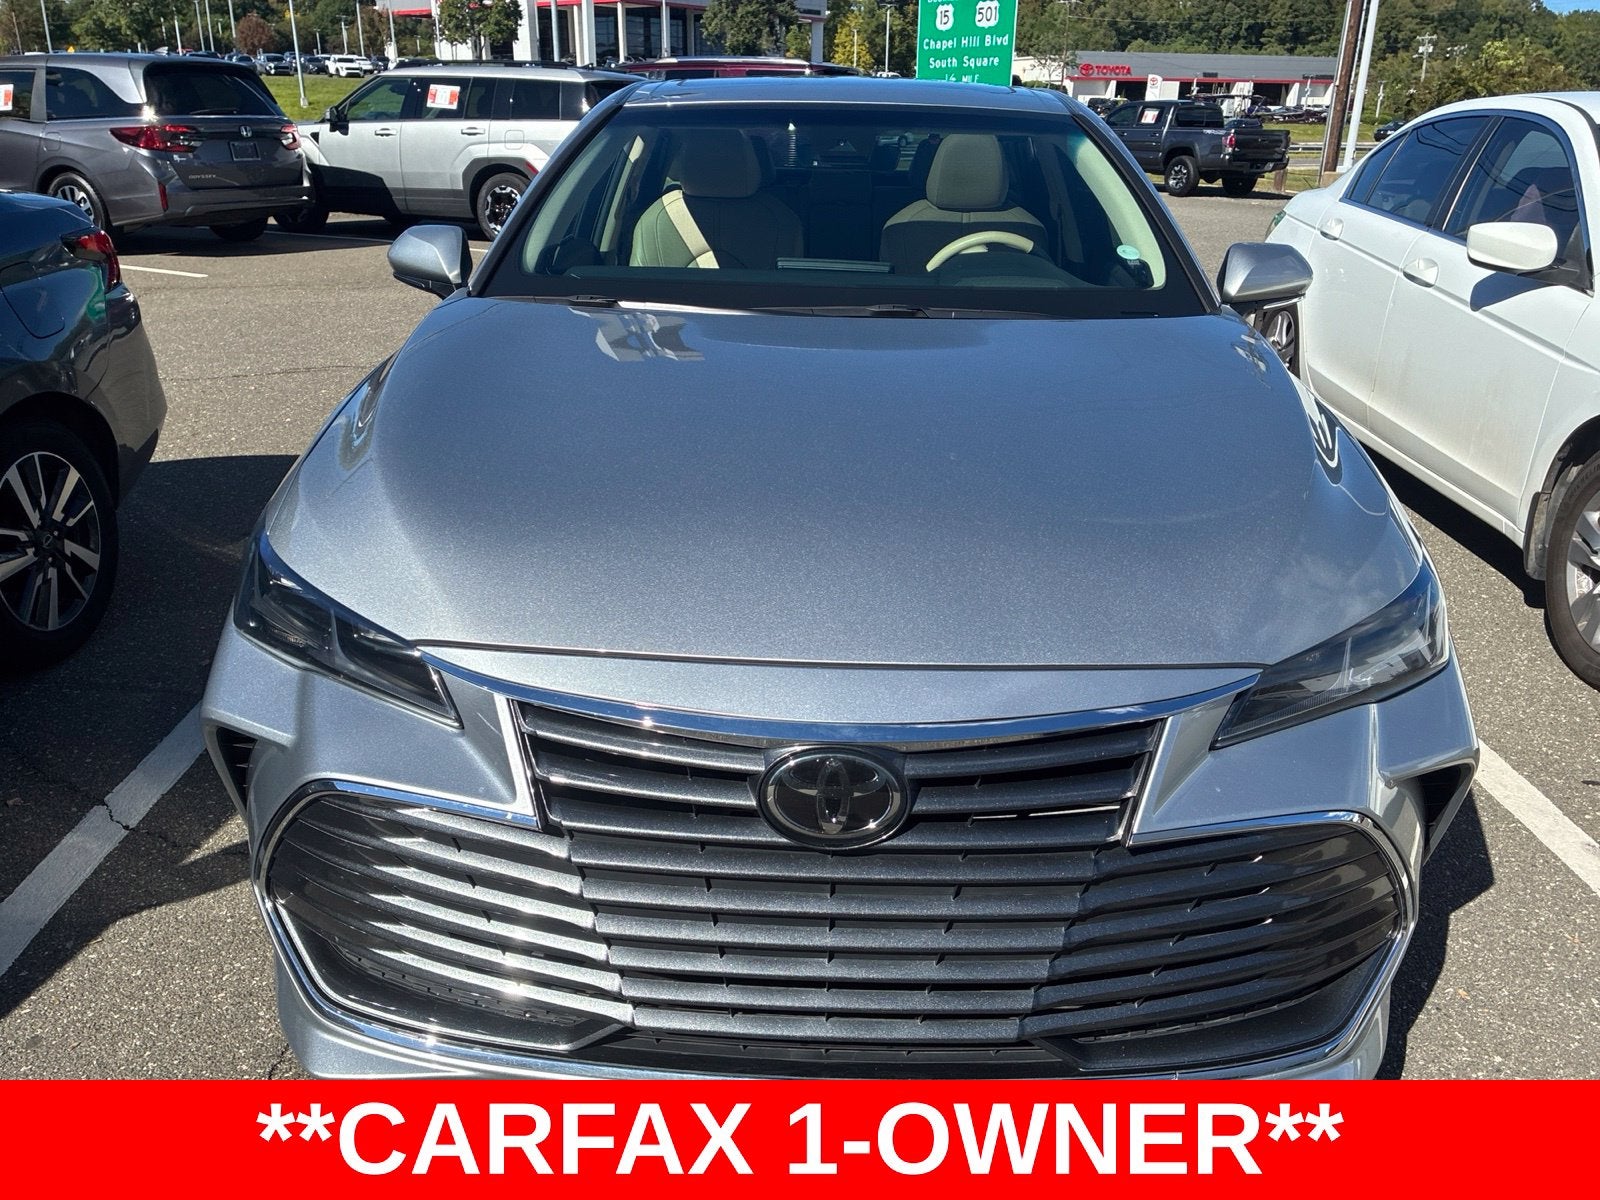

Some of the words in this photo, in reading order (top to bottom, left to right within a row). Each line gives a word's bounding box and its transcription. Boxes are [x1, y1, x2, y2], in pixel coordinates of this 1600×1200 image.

[940, 10, 949, 25] 15
[977, 6, 998, 22] 501
[923, 38, 957, 51] Chapel
[961, 36, 980, 48] Hill
[985, 34, 1009, 47] Blvd
[929, 57, 958, 69] South
[963, 56, 1000, 69] Square
[1096, 65, 1131, 76] TOYOTA
